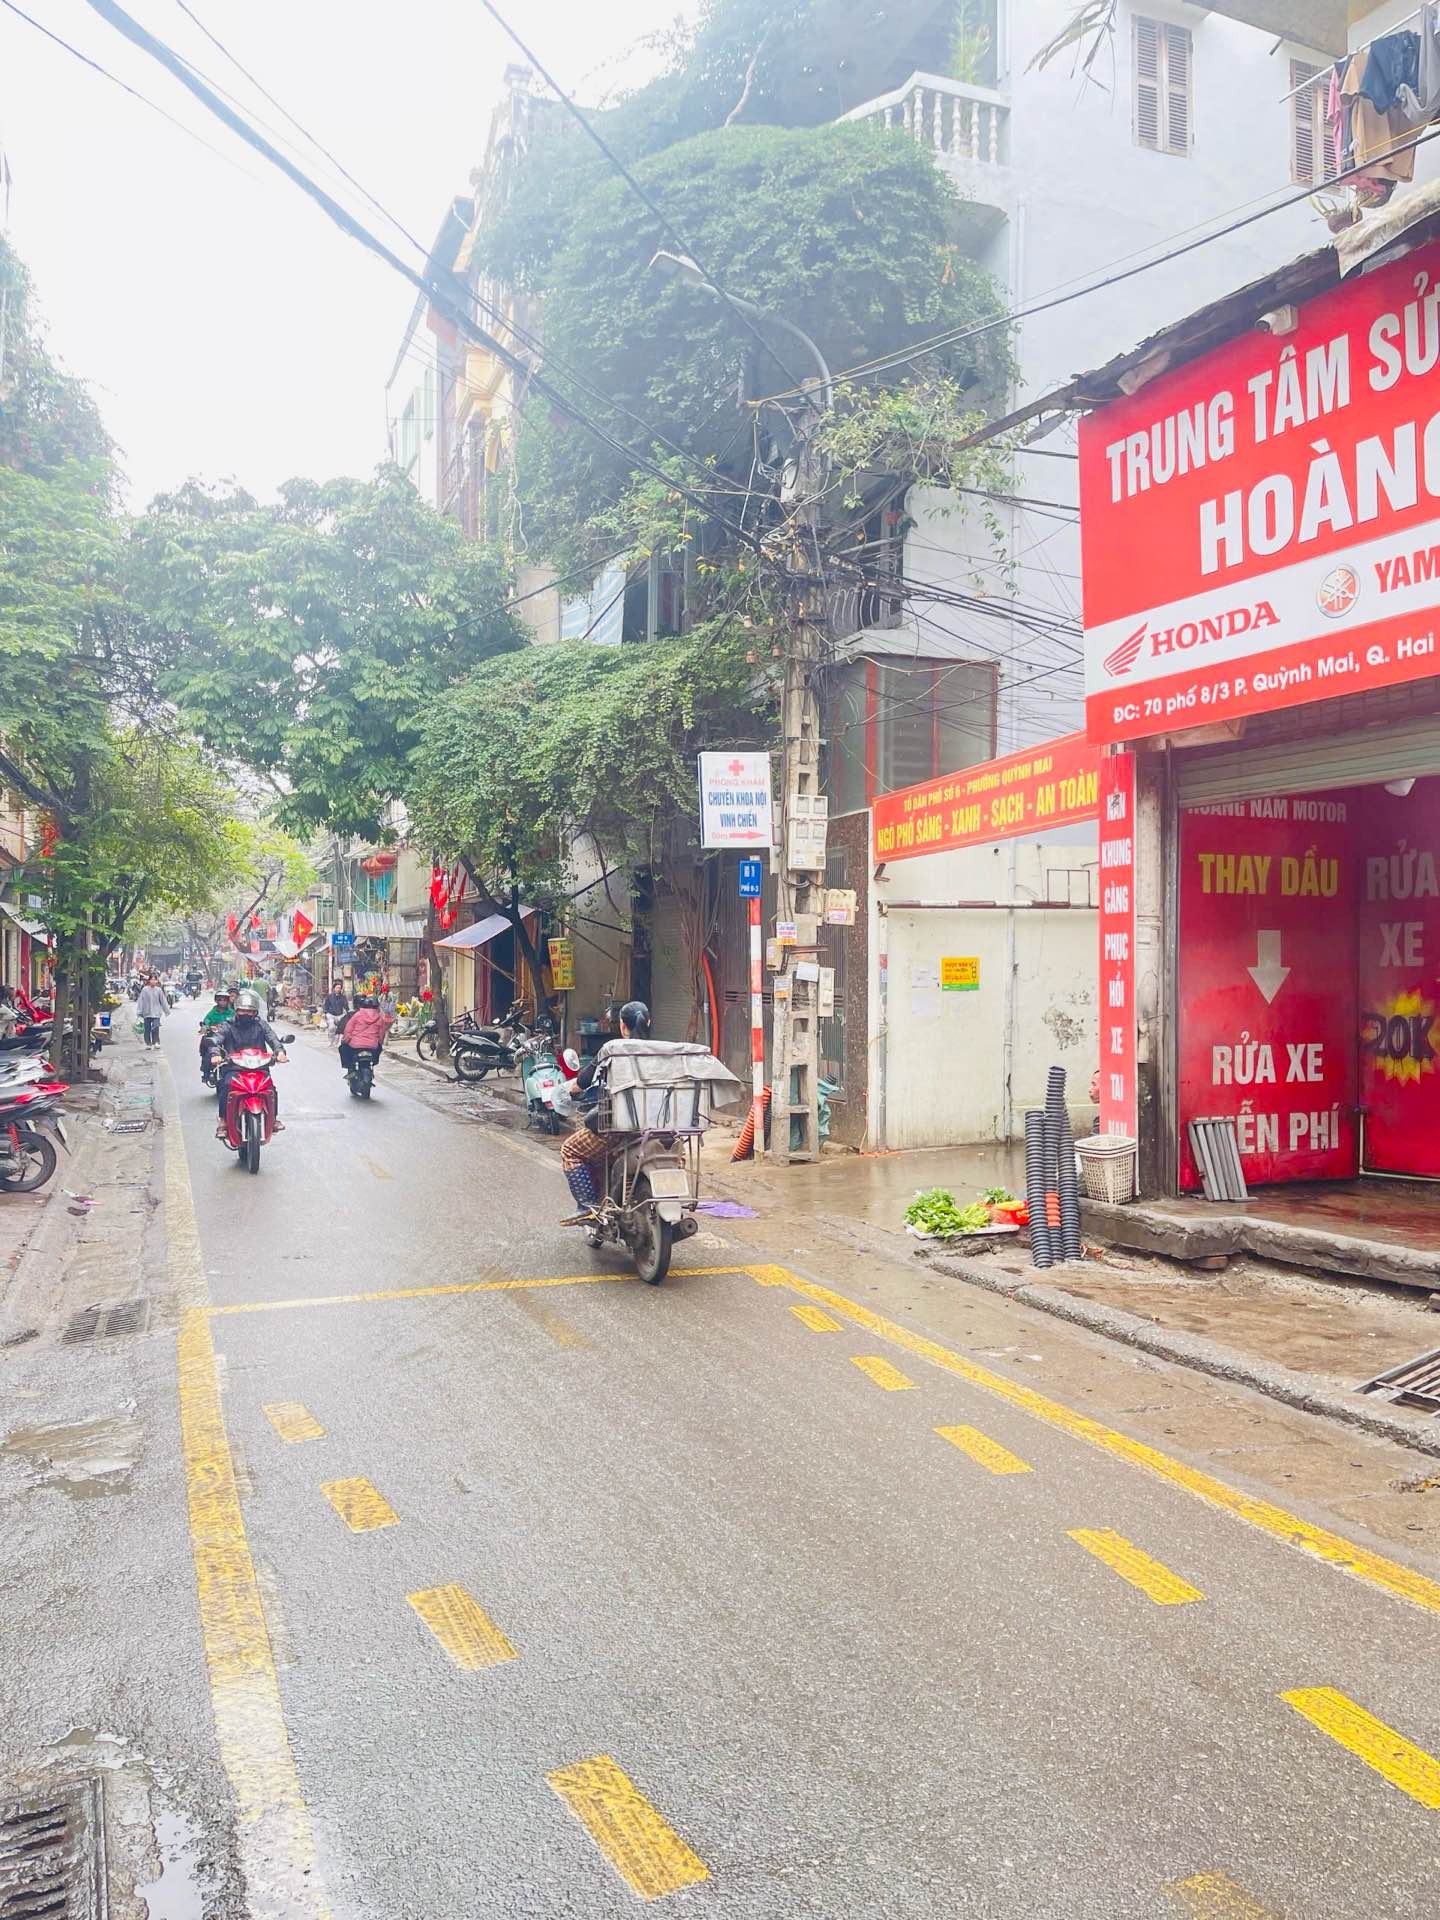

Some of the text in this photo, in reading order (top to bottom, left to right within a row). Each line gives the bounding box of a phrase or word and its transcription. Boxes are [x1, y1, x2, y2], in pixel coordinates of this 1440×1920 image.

[1106, 391, 1234, 503] TRUNG
[1248, 333, 1350, 444] TÂM
[1150, 601, 1280, 657] HONDA
[1113, 632, 1434, 724] ĐC: 70 phố 8/3 P. Quỳnh Mai, Q. Hai
[1033, 755, 1053, 776] MAI
[736, 791, 754, 806] KHOA
[877, 821, 895, 852] NGÕ
[896, 812, 914, 849] PHỐ
[916, 811, 943, 845] SÁNG
[951, 803, 981, 836] XANH
[991, 792, 1025, 833] SẠCH
[1036, 784, 1056, 817] AN
[1059, 768, 1098, 811] TOÀN
[1292, 800, 1348, 823] MOTOR
[1101, 838, 1132, 869] KHUNG
[1367, 838, 1440, 900] RỬA
[1198, 854, 1272, 895] THAY
[1104, 881, 1129, 914] CÀNG
[1104, 932, 1129, 966] PHỤC
[1379, 921, 1424, 967] XE
[1110, 1027, 1123, 1055] XE
[1212, 1031, 1324, 1085] RỬA XE
[1110, 1073, 1123, 1101] TAI
[1289, 1102, 1340, 1152] PHÍ
